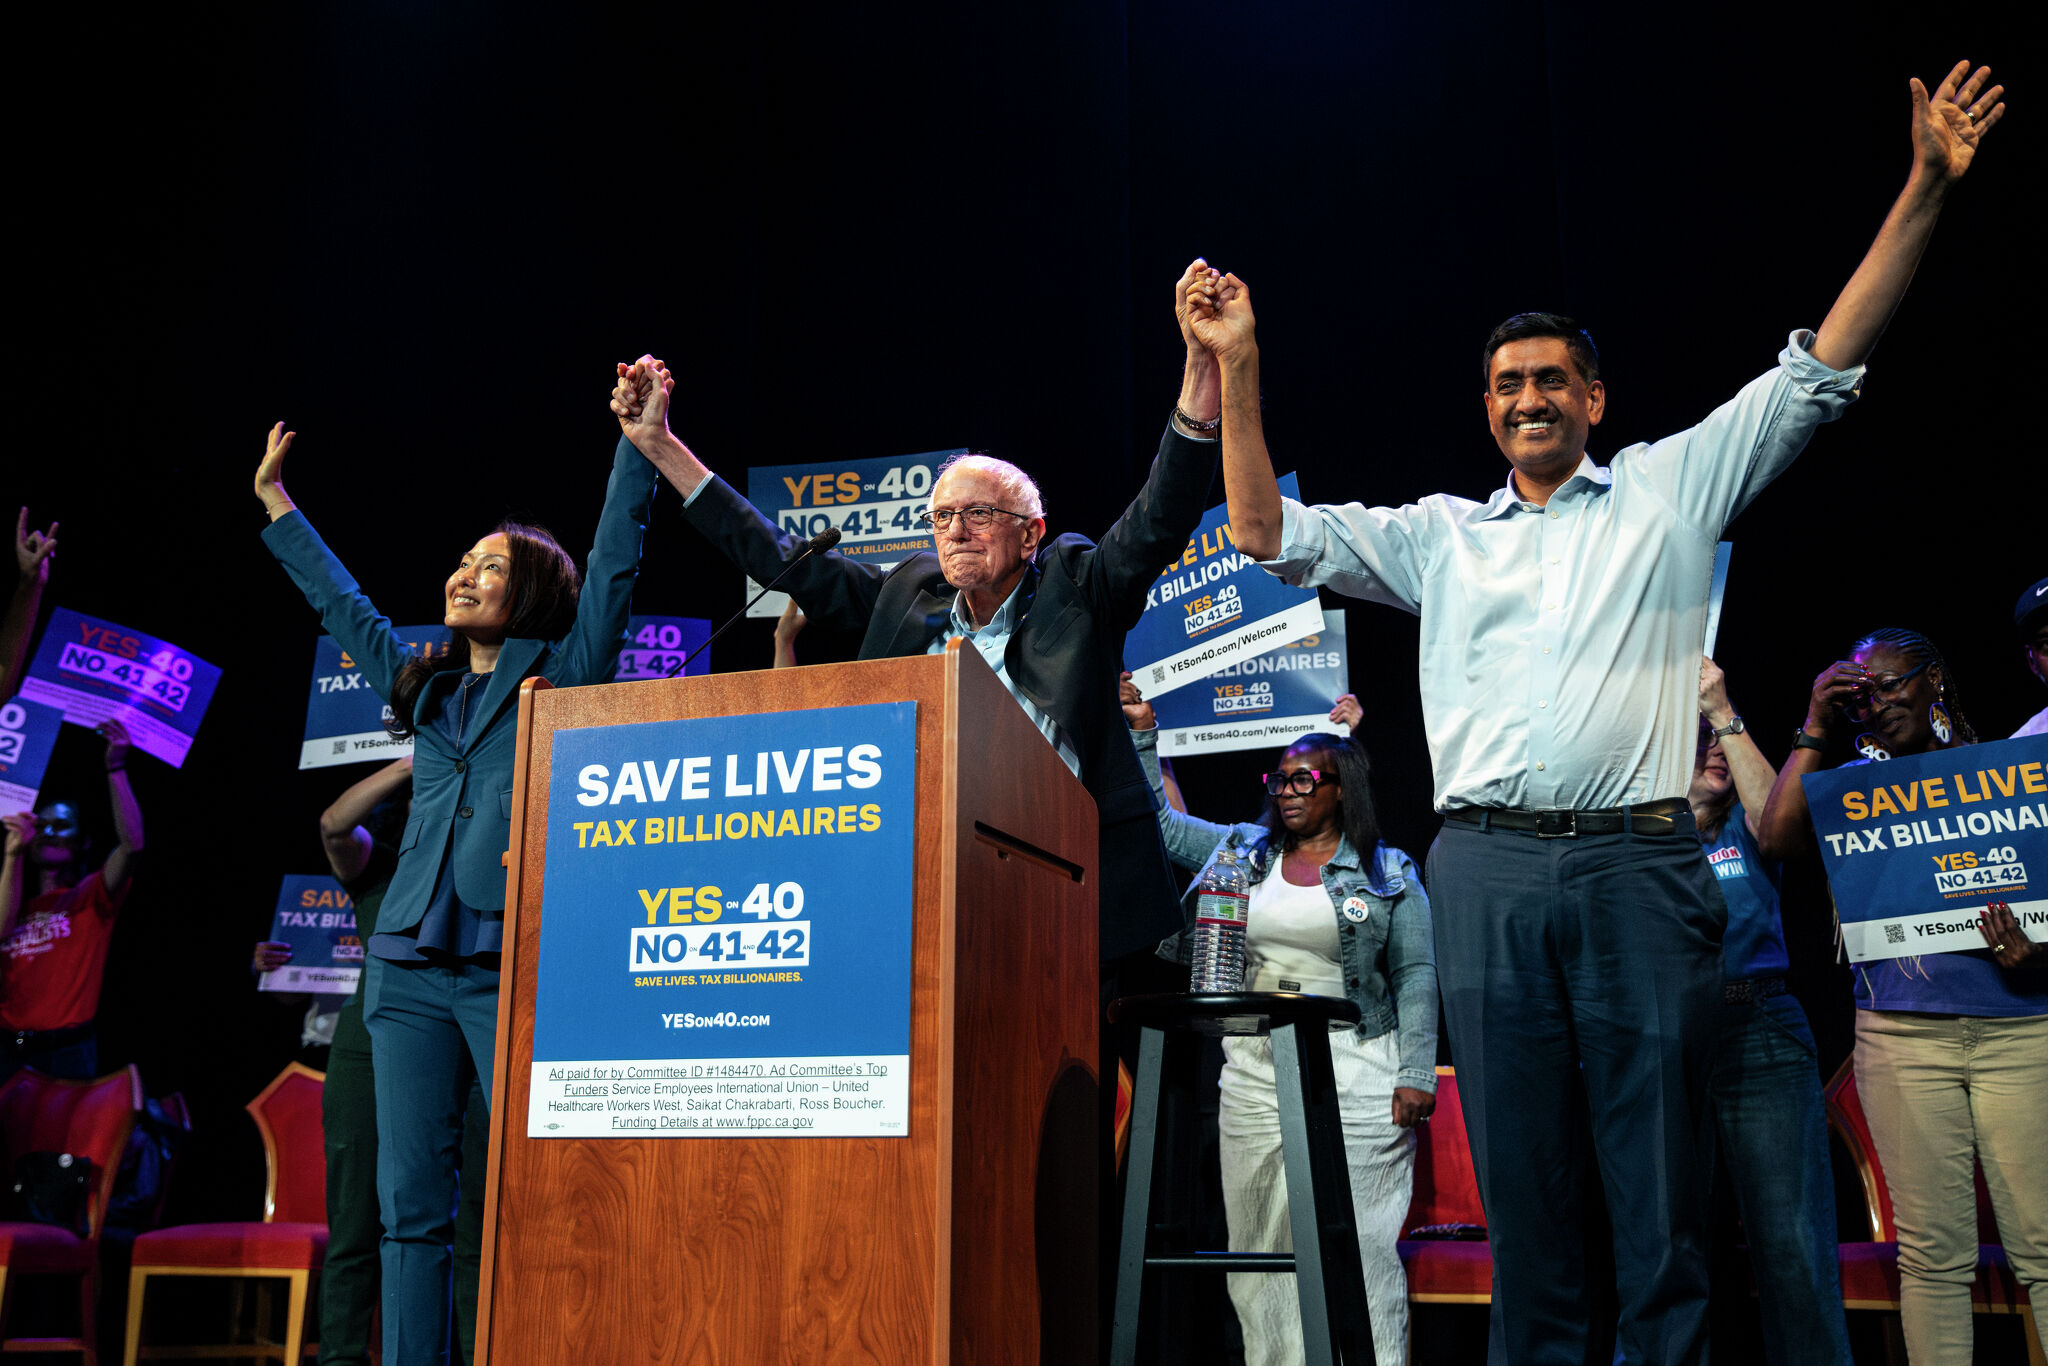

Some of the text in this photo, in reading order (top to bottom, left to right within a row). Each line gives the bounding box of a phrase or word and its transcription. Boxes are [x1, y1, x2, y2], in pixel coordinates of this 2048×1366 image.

[782, 465, 932, 507] YES ON 40
[785, 513, 831, 539] NO
[842, 509, 882, 536] 41
[891, 504, 932, 532] 42
[843, 540, 931, 556] TAX BILLIONAIRES.
[1184, 584, 1237, 616] YES 40
[1187, 616, 1204, 630] NO
[1207, 608, 1222, 621] 41
[1225, 600, 1240, 614] 42
[635, 624, 682, 649] 40
[1170, 621, 1287, 674] YESon40.com/Welcome
[80, 622, 194, 682] YES 40
[65, 647, 106, 672] NO
[113, 664, 145, 686] 41
[153, 681, 185, 706] 42
[646, 655, 682, 675] 42
[1206, 652, 1341, 679] LLIONAIRES
[317, 673, 362, 694] TAX
[1214, 681, 1270, 698] YES 40
[1215, 695, 1272, 710] NO 41 42
[1193, 723, 1315, 742] YESon40.com/Welcome
[1932, 719, 1950, 743] 40
[1860, 745, 1891, 761] 40
[576, 743, 882, 807] SAVE LIVES
[1842, 761, 2048, 821] SAVE LIVE
[573, 804, 882, 848] TAX BILLIONAIRES
[1824, 827, 1888, 857] TAX
[1715, 861, 1744, 877] WIN
[1932, 846, 2017, 872] YES 40
[1938, 866, 2025, 889] NO 41 42
[301, 889, 354, 908] SAV
[637, 881, 804, 925] YES ON 40
[1351, 899, 1366, 910] YES
[279, 911, 317, 927] TAX
[1348, 907, 1363, 918] 40
[636, 933, 688, 964] NO
[699, 931, 746, 961] 41
[757, 929, 805, 959] 42
[634, 971, 803, 987] SAVE LIVES. TAX BILLIONAIRES.
[549, 1063, 888, 1081] Ad paid for by Committee ID #1484470. Ad Committee's Top
[564, 1083, 609, 1096] Funders
[612, 1083, 651, 1095] Service
[654, 1082, 713, 1096] Employees
[716, 1081, 783, 1093] International
[786, 1081, 819, 1092] Union
[832, 1080, 869, 1092] United
[548, 1097, 885, 1112] Healthcare Workers West, Saikat Chakrabarti, Ross Boucher.
[612, 1115, 814, 1130] Funding Details at www.fppc.ca.gov
